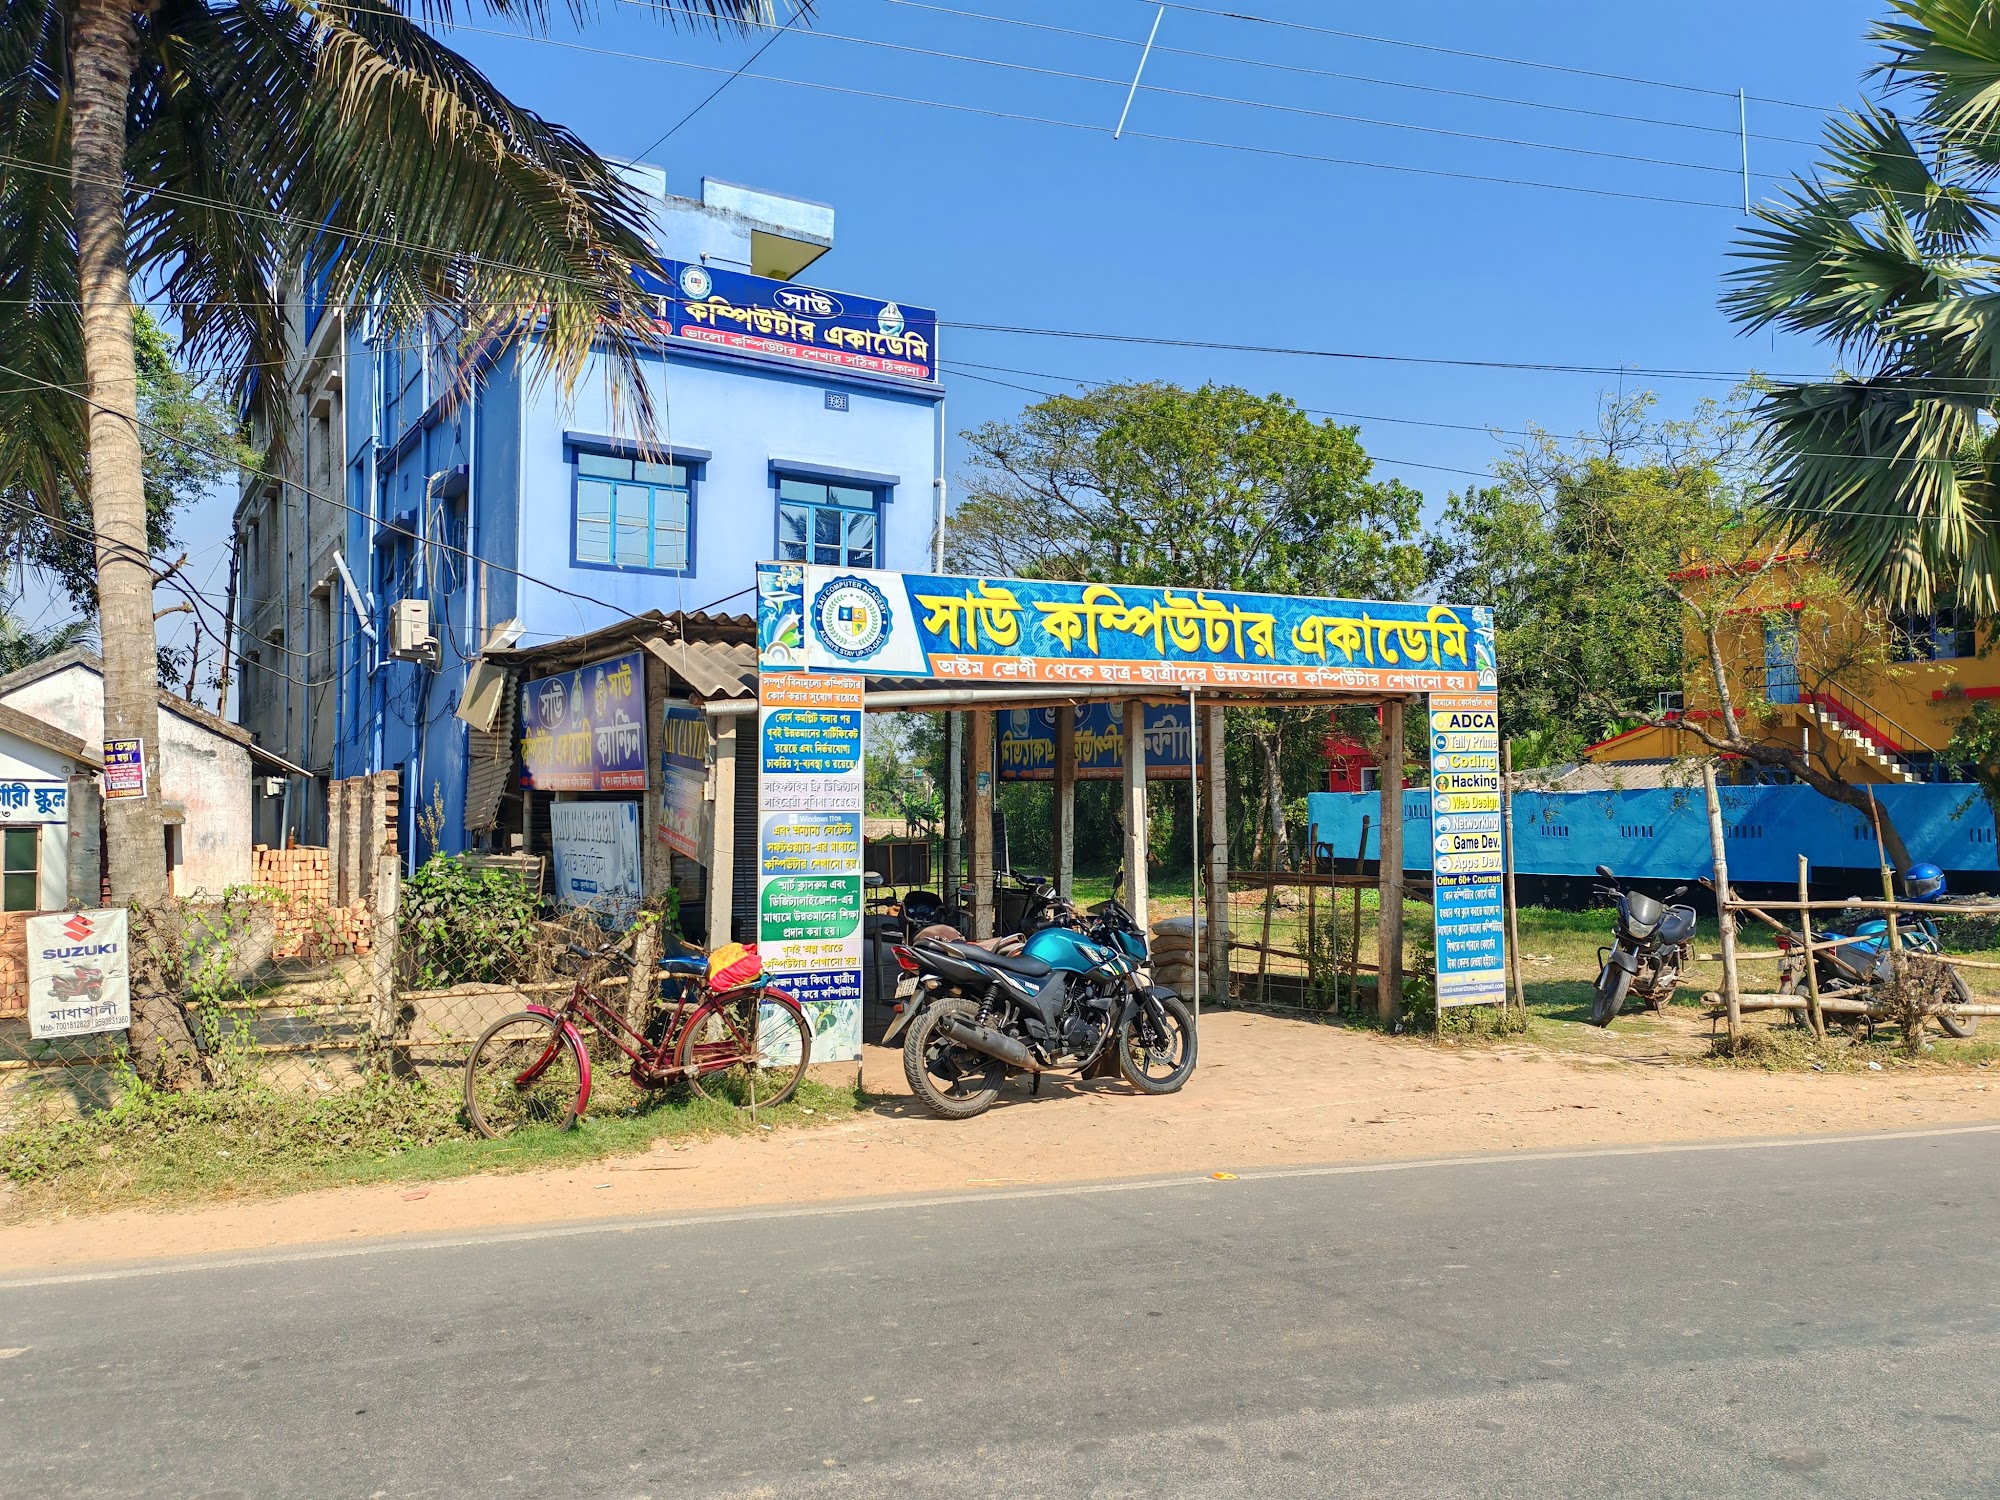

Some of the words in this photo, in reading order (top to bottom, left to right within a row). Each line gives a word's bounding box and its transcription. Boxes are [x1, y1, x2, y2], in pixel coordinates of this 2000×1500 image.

[780, 291, 833, 315] সাউ
[685, 296, 816, 341] কম্পিউটার
[824, 326, 929, 361] একাডেমি
[684, 329, 726, 342] ভালো
[730, 334, 797, 356] কম্পিউটার
[802, 349, 841, 363] শেখার
[846, 354, 879, 369] সঠিক
[817, 595, 827, 610] SAU
[826, 580, 862, 596] COMPUTER
[862, 585, 887, 614] ACADEMY
[914, 579, 1023, 651] সাউ
[1032, 585, 1278, 662] কম্পিউটার
[1292, 606, 1470, 668] একাডেমি
[819, 630, 839, 652] ALWAYS
[839, 648, 855, 657] STAY
[936, 654, 984, 676] অষ্টম
[992, 656, 1037, 678] শ্রেণী
[1044, 660, 1095, 679] থেকে
[1212, 664, 1298, 684] উন্নতমানের
[1303, 667, 1380, 688] কম্পিউটার
[1386, 672, 1442, 690] শেখানো
[607, 661, 632, 699] সাউ
[763, 675, 787, 689] সম্পূর্ণ
[788, 675, 822, 690] বিনামূল্যে
[824, 676, 862, 689] কম্পিউটার
[540, 681, 564, 722] সাউ
[766, 690, 787, 700] কোর্স
[788, 692, 808, 701] করার
[809, 693, 833, 704] সুযোগ
[776, 710, 794, 723] কোর্স
[820, 714, 838, 724] করার
[840, 714, 850, 724] পর
[1450, 714, 1495, 728] ADCA
[594, 708, 641, 766] ক্যান্টিন
[767, 726, 782, 741] খুবই
[822, 726, 860, 739] সার্টিফিকেট
[800, 744, 814, 754] এবং
[815, 741, 850, 754] নির্ভরযোগ্য
[1450, 735, 1470, 751] Tally
[1473, 735, 1498, 748] Prime
[766, 756, 792, 768] চাকরির
[824, 760, 830, 768] ও
[1450, 754, 1497, 770] Coding
[1452, 774, 1498, 790] Hacking
[34, 789, 66, 815] স্কুল
[1453, 796, 1470, 809] Web
[1472, 796, 1499, 811] Design
[773, 826, 791, 836] এবং
[792, 825, 820, 837] অন্যান্য
[1452, 815, 1500, 832] Networking
[830, 842, 858, 853] মাধ্যমে
[1454, 836, 1479, 850] Game
[1482, 835, 1500, 848] Dev.
[764, 856, 807, 871] কম্পিউটার
[810, 858, 842, 870] শেখানো
[1454, 856, 1479, 871] Apps
[1482, 856, 1501, 868] Dev.
[777, 878, 796, 892] স্মার্ট
[798, 880, 828, 892] ক্লাসরুম
[830, 880, 846, 889] এবং
[1437, 876, 1457, 885] Other
[1458, 875, 1471, 884] 60+
[1472, 875, 1501, 883] Courses
[1453, 887, 1474, 901] কম্পিউটার
[763, 913, 791, 923] মাধ্যমে
[793, 909, 837, 922] উন্নতমানের
[839, 908, 860, 920] শিক্ষা
[783, 928, 804, 938] প্রদান
[805, 927, 822, 937] করা
[42, 943, 117, 959] SUZUKI
[782, 944, 802, 958] খুবই
[820, 944, 843, 953] খরচে
[762, 958, 807, 970] কম্পিউটার
[810, 957, 842, 968] শেখানো
[793, 977, 808, 986] ছাত্র
[810, 974, 831, 985] কিংবা
[833, 972, 855, 984] ছাত্রীর
[801, 990, 819, 998] করে
[821, 986, 860, 998] কম্পিউটার
[49, 1001, 118, 1020] মাধাখালী
